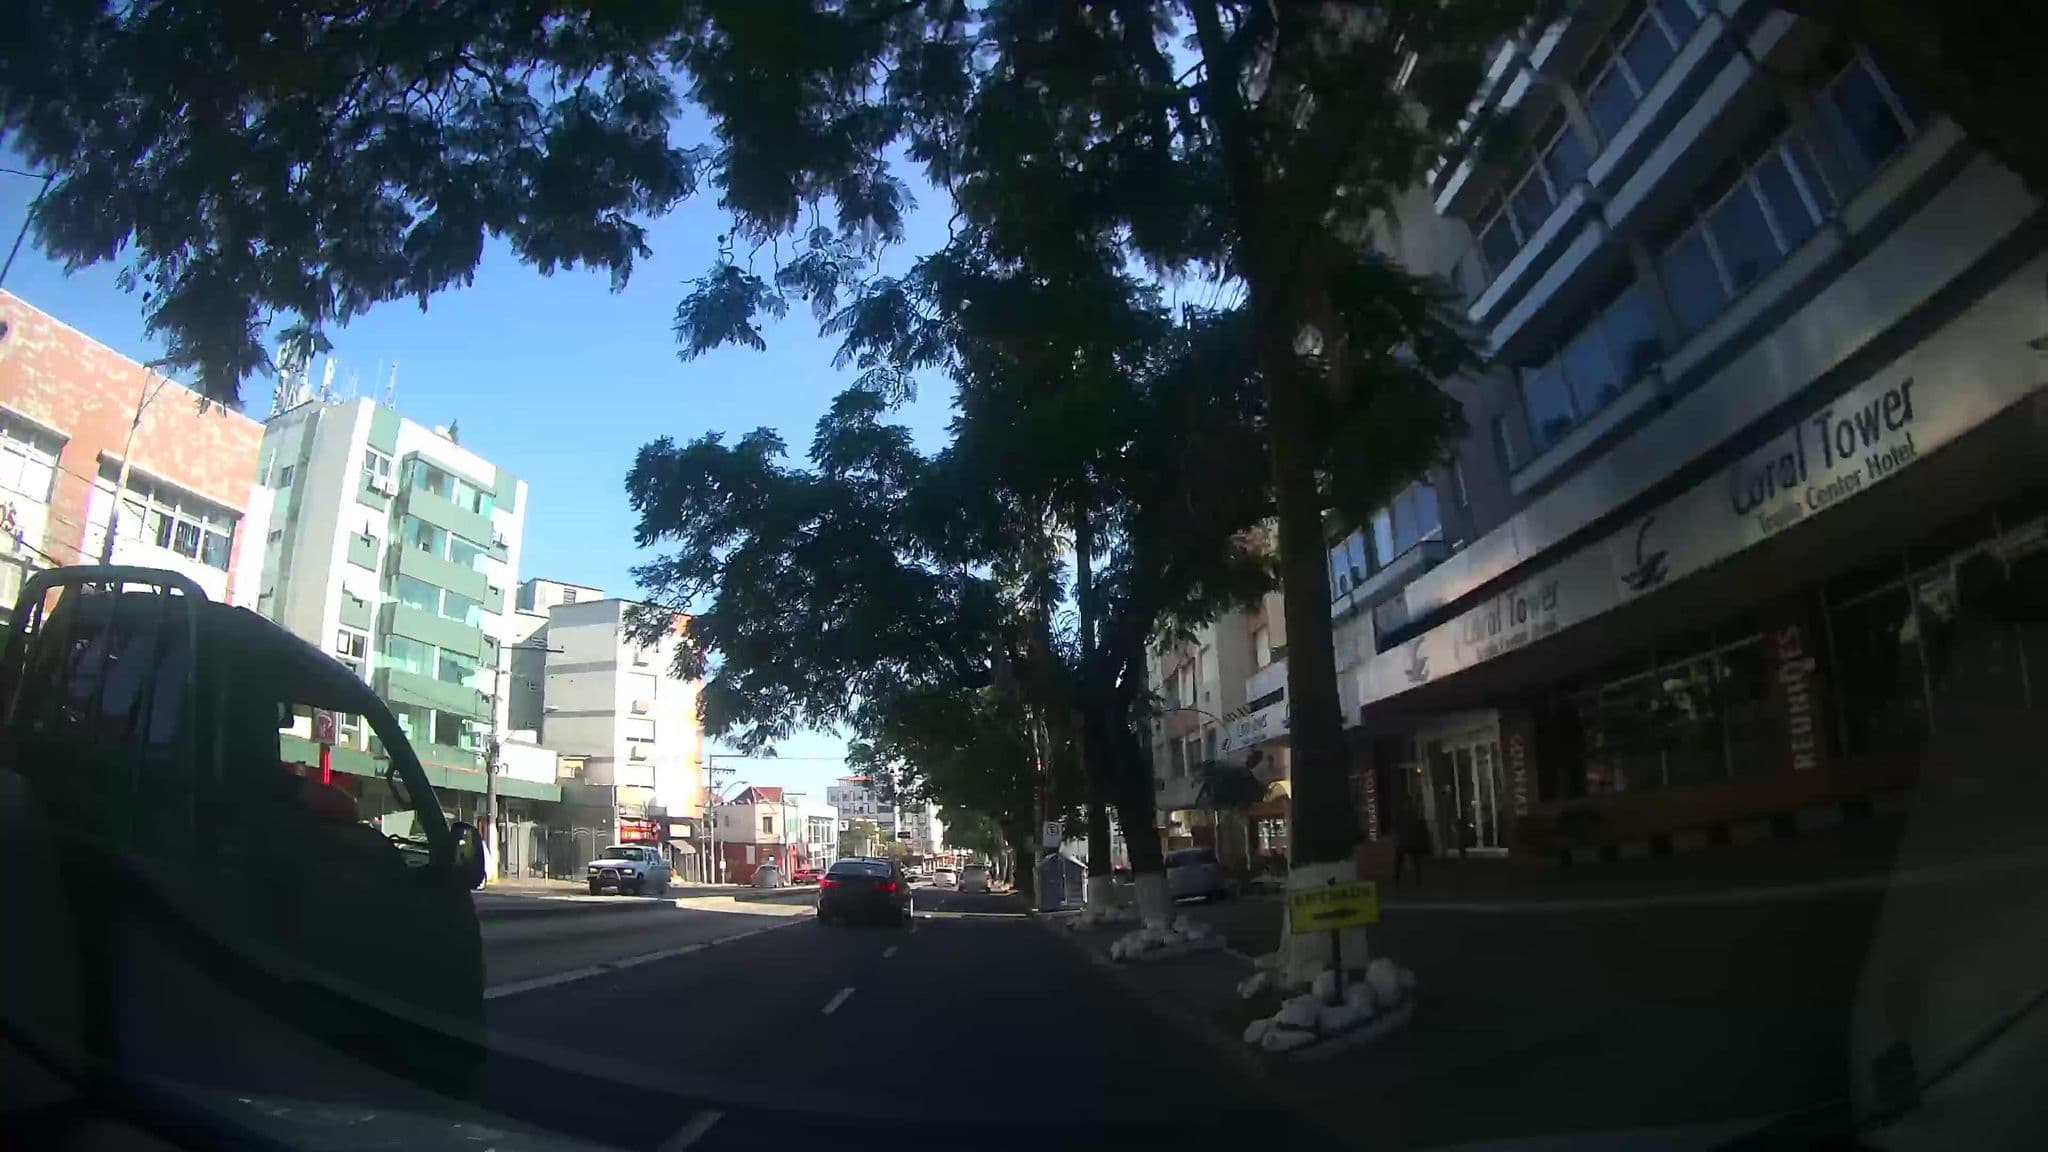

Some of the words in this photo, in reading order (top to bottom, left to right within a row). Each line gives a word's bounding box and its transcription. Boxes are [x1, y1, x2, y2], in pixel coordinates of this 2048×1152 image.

[1730, 424, 1807, 515] Coral
[1813, 376, 1915, 469] Tower
[1805, 470, 1861, 510] Center
[1864, 432, 1917, 479] Hotel
